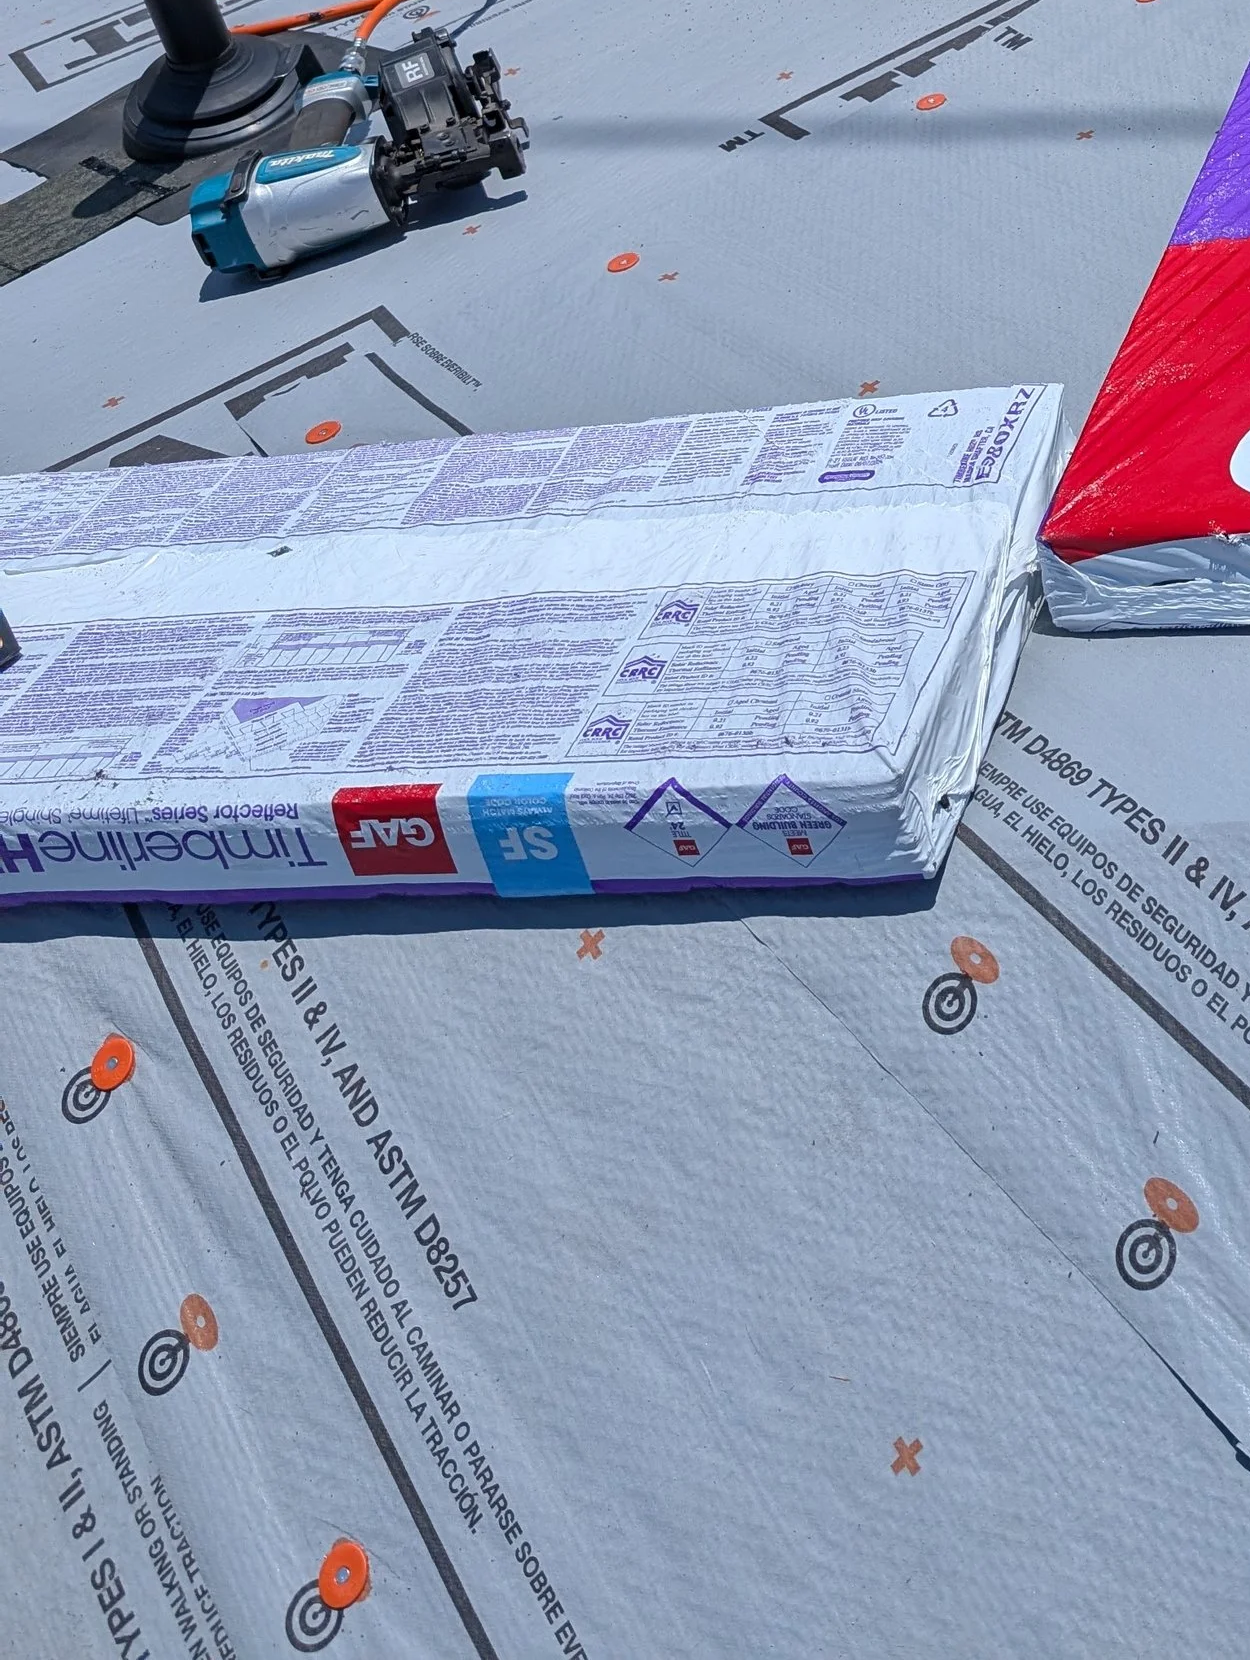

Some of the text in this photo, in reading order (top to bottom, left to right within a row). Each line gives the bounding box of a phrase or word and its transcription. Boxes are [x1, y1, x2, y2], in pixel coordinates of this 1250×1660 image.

[405, 59, 425, 84] RF
[268, 149, 335, 167] makita
[420, 341, 447, 365] SOBRE
[214, 802, 300, 825] Reflector
[482, 797, 546, 806] COLOR CODE
[482, 806, 552, 816] ALWAYS MATCH
[351, 816, 436, 838] GAF
[496, 825, 557, 860] SF
[752, 820, 831, 830] GREEN BUILDING
[1021, 733, 1093, 787] D4869
[1086, 777, 1166, 846] TYPES
[1161, 834, 1190, 867] II
[1184, 856, 1210, 889] &
[1207, 874, 1248, 922] IV,
[677, 843, 696, 851] GAF
[789, 843, 809, 851] GAF
[1021, 794, 1055, 822] USE
[1047, 814, 1119, 880] EQUIPOS
[1114, 872, 1145, 904] DE
[1141, 895, 1240, 989] SEGURIDAD
[170, 916, 201, 943] EL
[1002, 810, 1024, 833] EL
[1020, 824, 1070, 878] HIELO,
[1070, 868, 1108, 907] LOS
[1104, 899, 1193, 983] RESIDUOS
[1190, 978, 1208, 998] O
[1205, 991, 1230, 1023] EL
[188, 939, 218, 998] HIELO,
[210, 991, 237, 1030] LOS
[226, 1026, 280, 1118] RESIDUOS
[241, 893, 479, 1312] TYPES II & IV, AND ASTM D8257
[272, 1115, 289, 1134] O
[279, 1131, 301, 1162] EL
[25, 1234, 51, 1279] USE
[321, 1218, 371, 1302] PUEDEN
[210, 930, 254, 1007] EQUIPOS
[243, 1002, 267, 1034] DE
[257, 1028, 315, 1132] SEGURIDAD
[308, 1127, 325, 1146] Y
[317, 1143, 356, 1211] TENGA
[349, 1209, 400, 1299] CUIDADO
[390, 1299, 413, 1330] AL
[406, 1326, 461, 1425] CAMINAR
[453, 1421, 471, 1442] O
[462, 1440, 524, 1546] PARARSE
[514, 1541, 565, 1626] SOBRE
[0, 1281, 34, 1380] D48
[41, 1274, 86, 1363] SIEMPRE
[359, 1296, 414, 1393] REDUCIR
[17, 1373, 73, 1471] ASTM
[404, 1386, 428, 1424] LA
[93, 1399, 143, 1505] STANDING
[58, 1466, 86, 1513] II,
[420, 1416, 484, 1535] TRACCIÓN.
[71, 1503, 97, 1540] &
[134, 1501, 156, 1539] OR
[81, 1537, 105, 1563] I
[148, 1536, 198, 1643] WALKING
